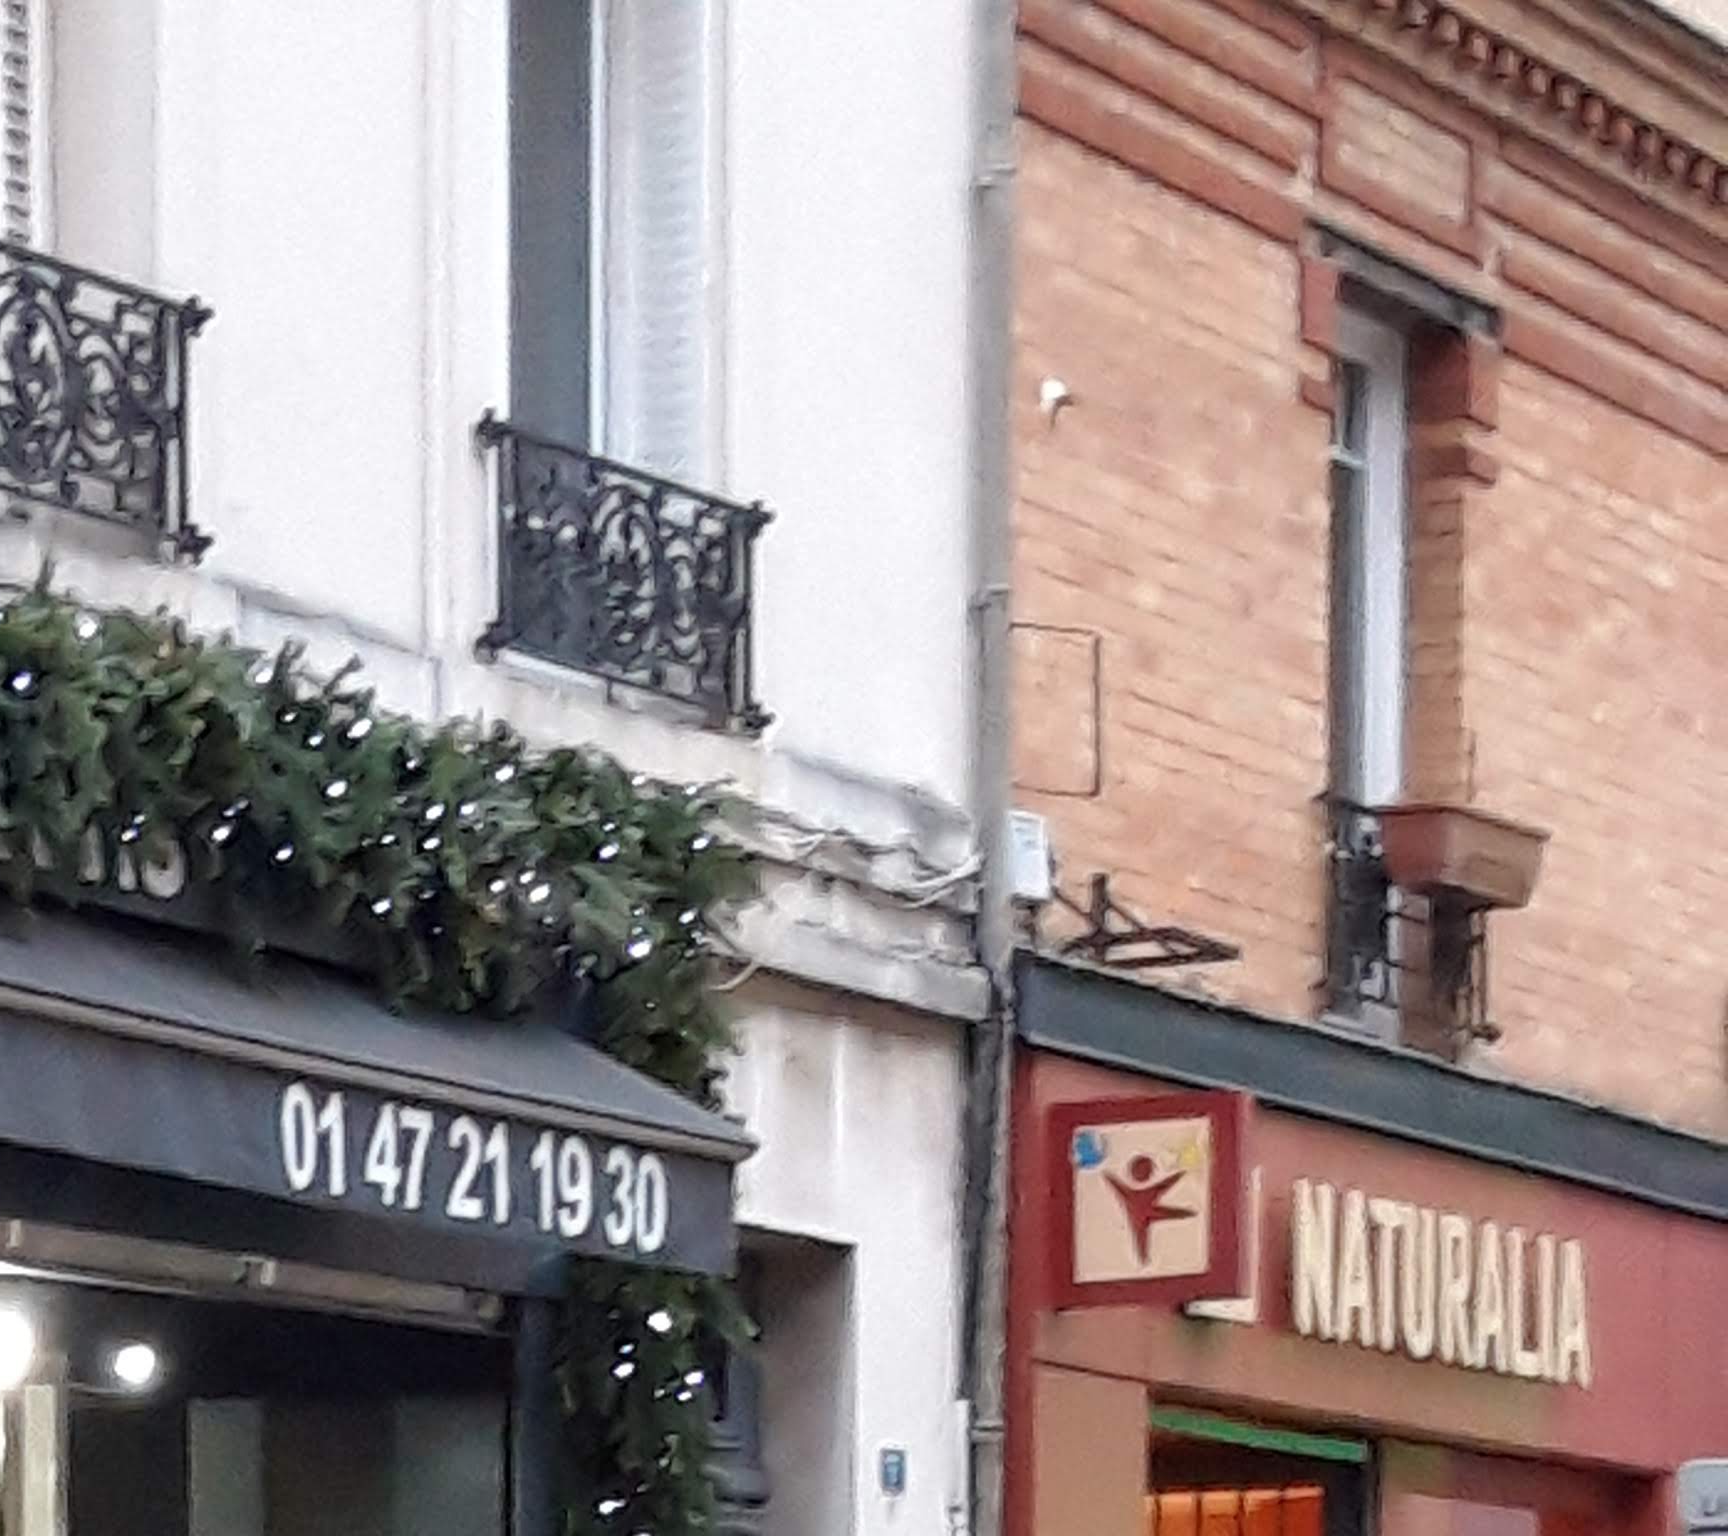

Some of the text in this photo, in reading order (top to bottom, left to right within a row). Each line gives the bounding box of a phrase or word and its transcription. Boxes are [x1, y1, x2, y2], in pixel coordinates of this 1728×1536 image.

[279, 1083, 669, 1255] 01 47 21 19 30
[1289, 1176, 1594, 1390] NATURALIA
